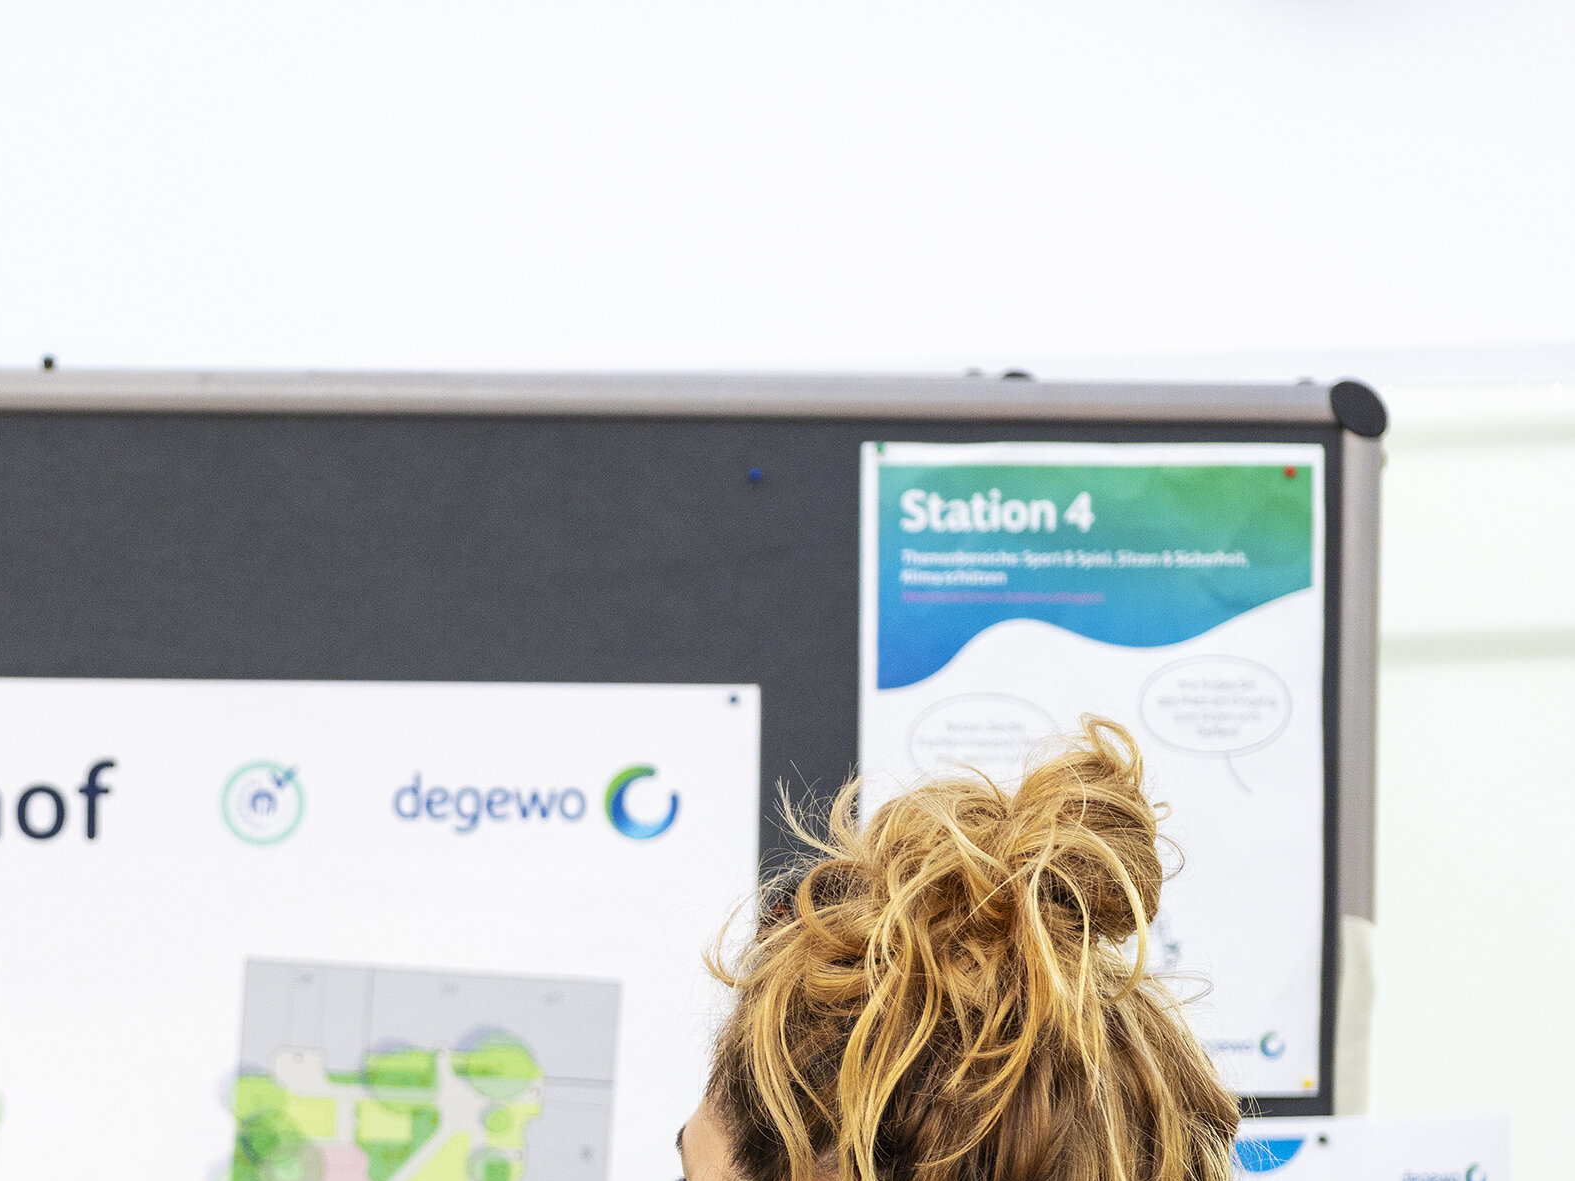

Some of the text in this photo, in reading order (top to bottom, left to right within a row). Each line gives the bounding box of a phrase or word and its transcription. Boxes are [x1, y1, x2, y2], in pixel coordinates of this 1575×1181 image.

[899, 487, 1094, 534] Station 4
[392, 770, 587, 835] degewo
